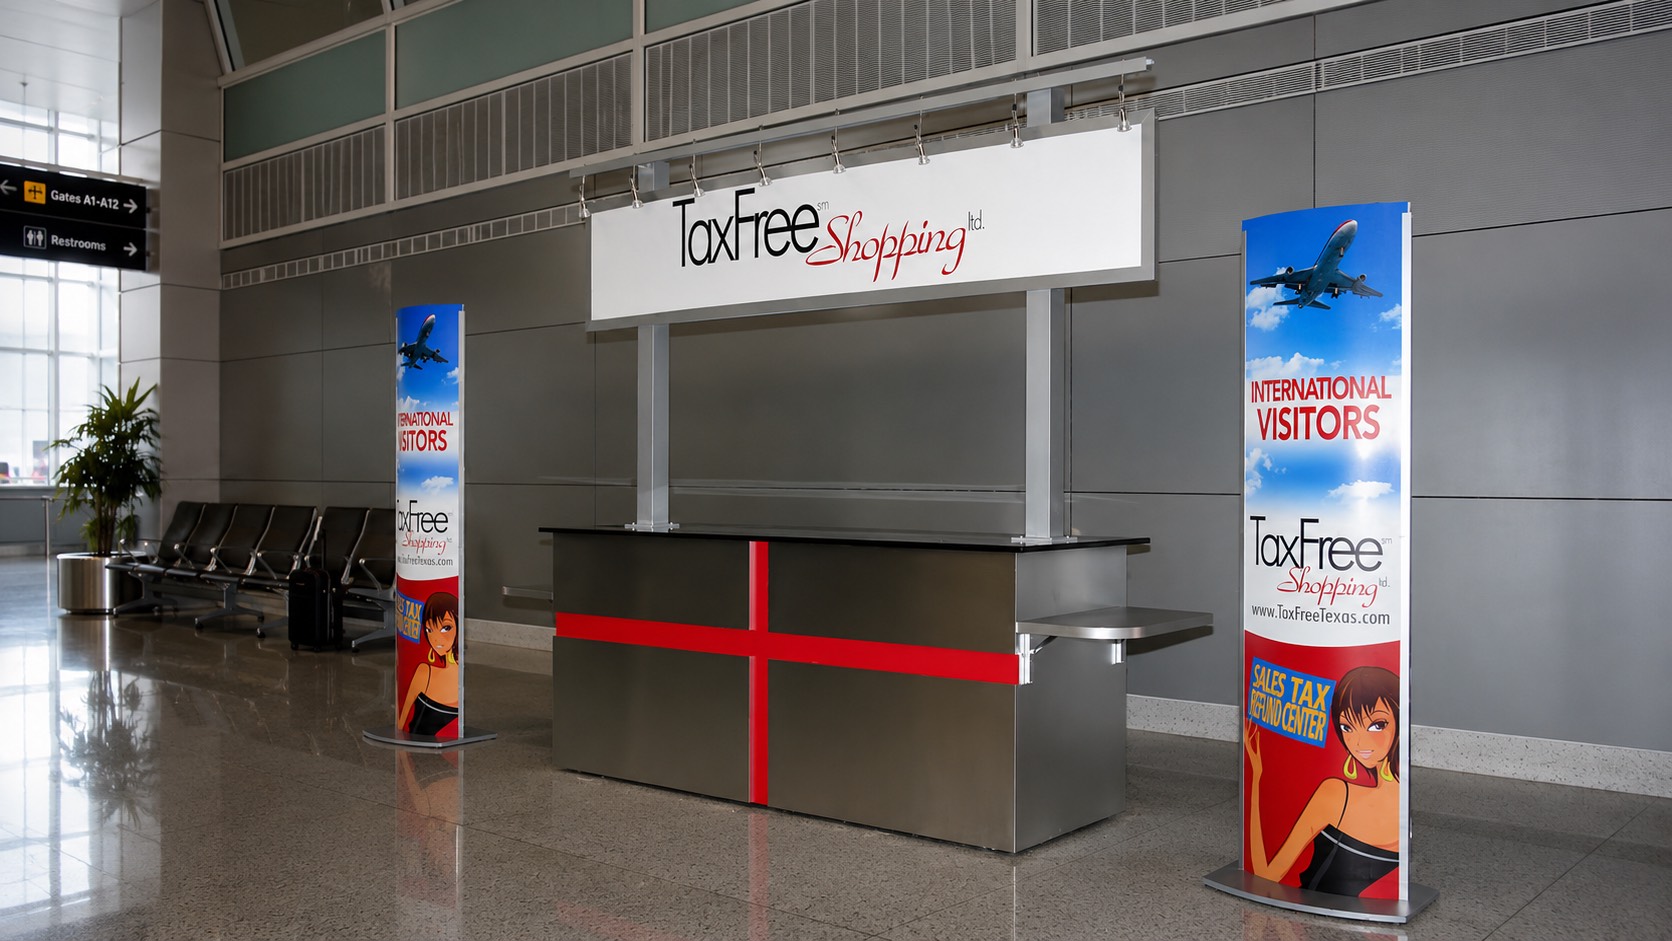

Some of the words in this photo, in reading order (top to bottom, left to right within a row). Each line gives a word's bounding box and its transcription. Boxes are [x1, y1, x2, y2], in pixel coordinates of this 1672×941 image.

[50, 189, 81, 204] Gates
[83, 194, 119, 210] A1-A12
[816, 201, 829, 211] sm
[672, 187, 820, 267] TaxFree
[967, 209, 985, 231] ltd.
[51, 234, 107, 251] Restrooms
[805, 210, 967, 283] Shopping
[1251, 375, 1393, 403] INTERNATIONAL
[1257, 404, 1381, 441] VISITORS
[1250, 516, 1383, 572] TaxFree
[1276, 565, 1379, 608] Shopping
[1252, 664, 1287, 698] SALES
[1291, 676, 1331, 712] TAX
[1250, 688, 1282, 727] REFUND
[1281, 702, 1327, 742] CENTER
